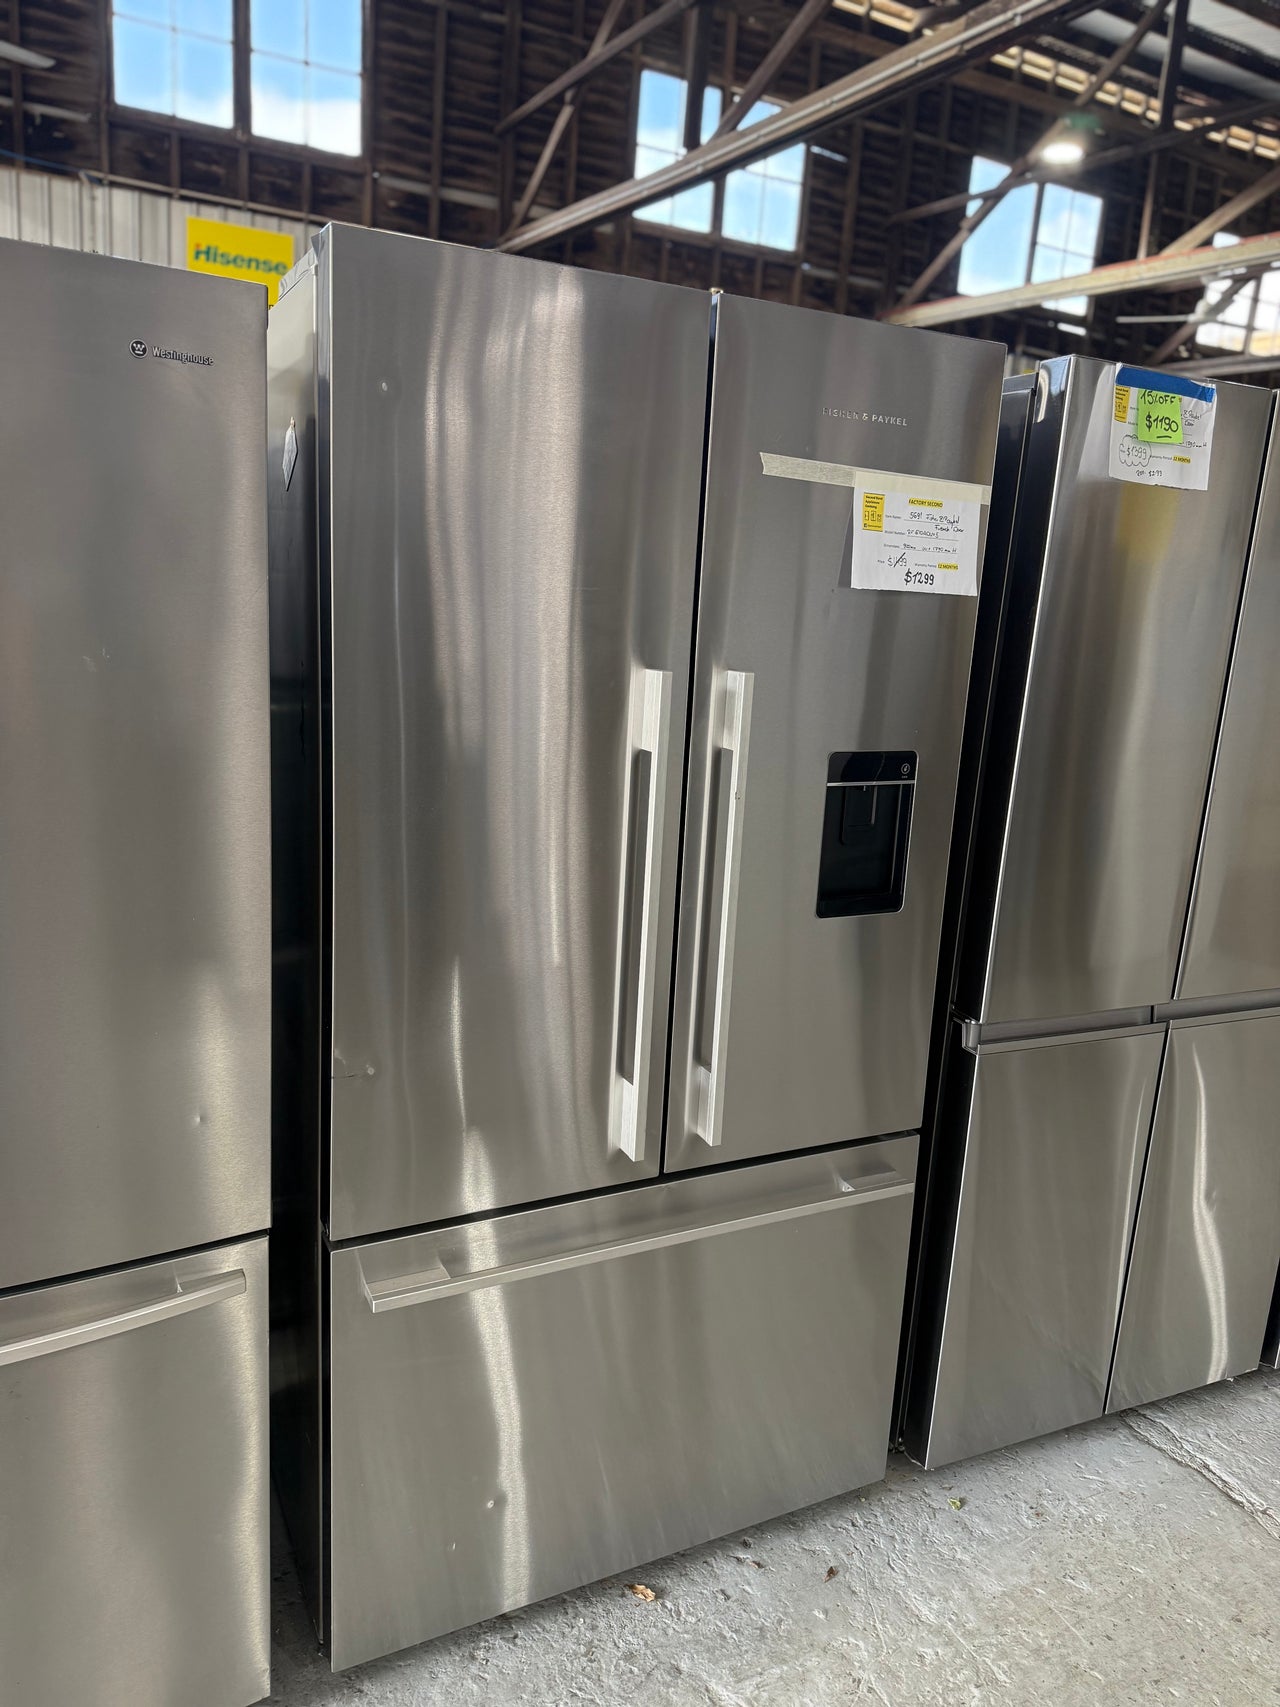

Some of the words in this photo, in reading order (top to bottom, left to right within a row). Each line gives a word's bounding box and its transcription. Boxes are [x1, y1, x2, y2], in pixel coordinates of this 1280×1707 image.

[194, 243, 287, 276] Hisense
[152, 346, 215, 366] Westinghouse
[822, 407, 859, 420] FISHER
[862, 412, 869, 421] &
[871, 414, 908, 427] PAYKEL
[1145, 411, 1179, 433] $1190
[908, 498, 927, 507] FACTORY
[927, 500, 944, 509] SECOND
[904, 568, 935, 585] $1299
